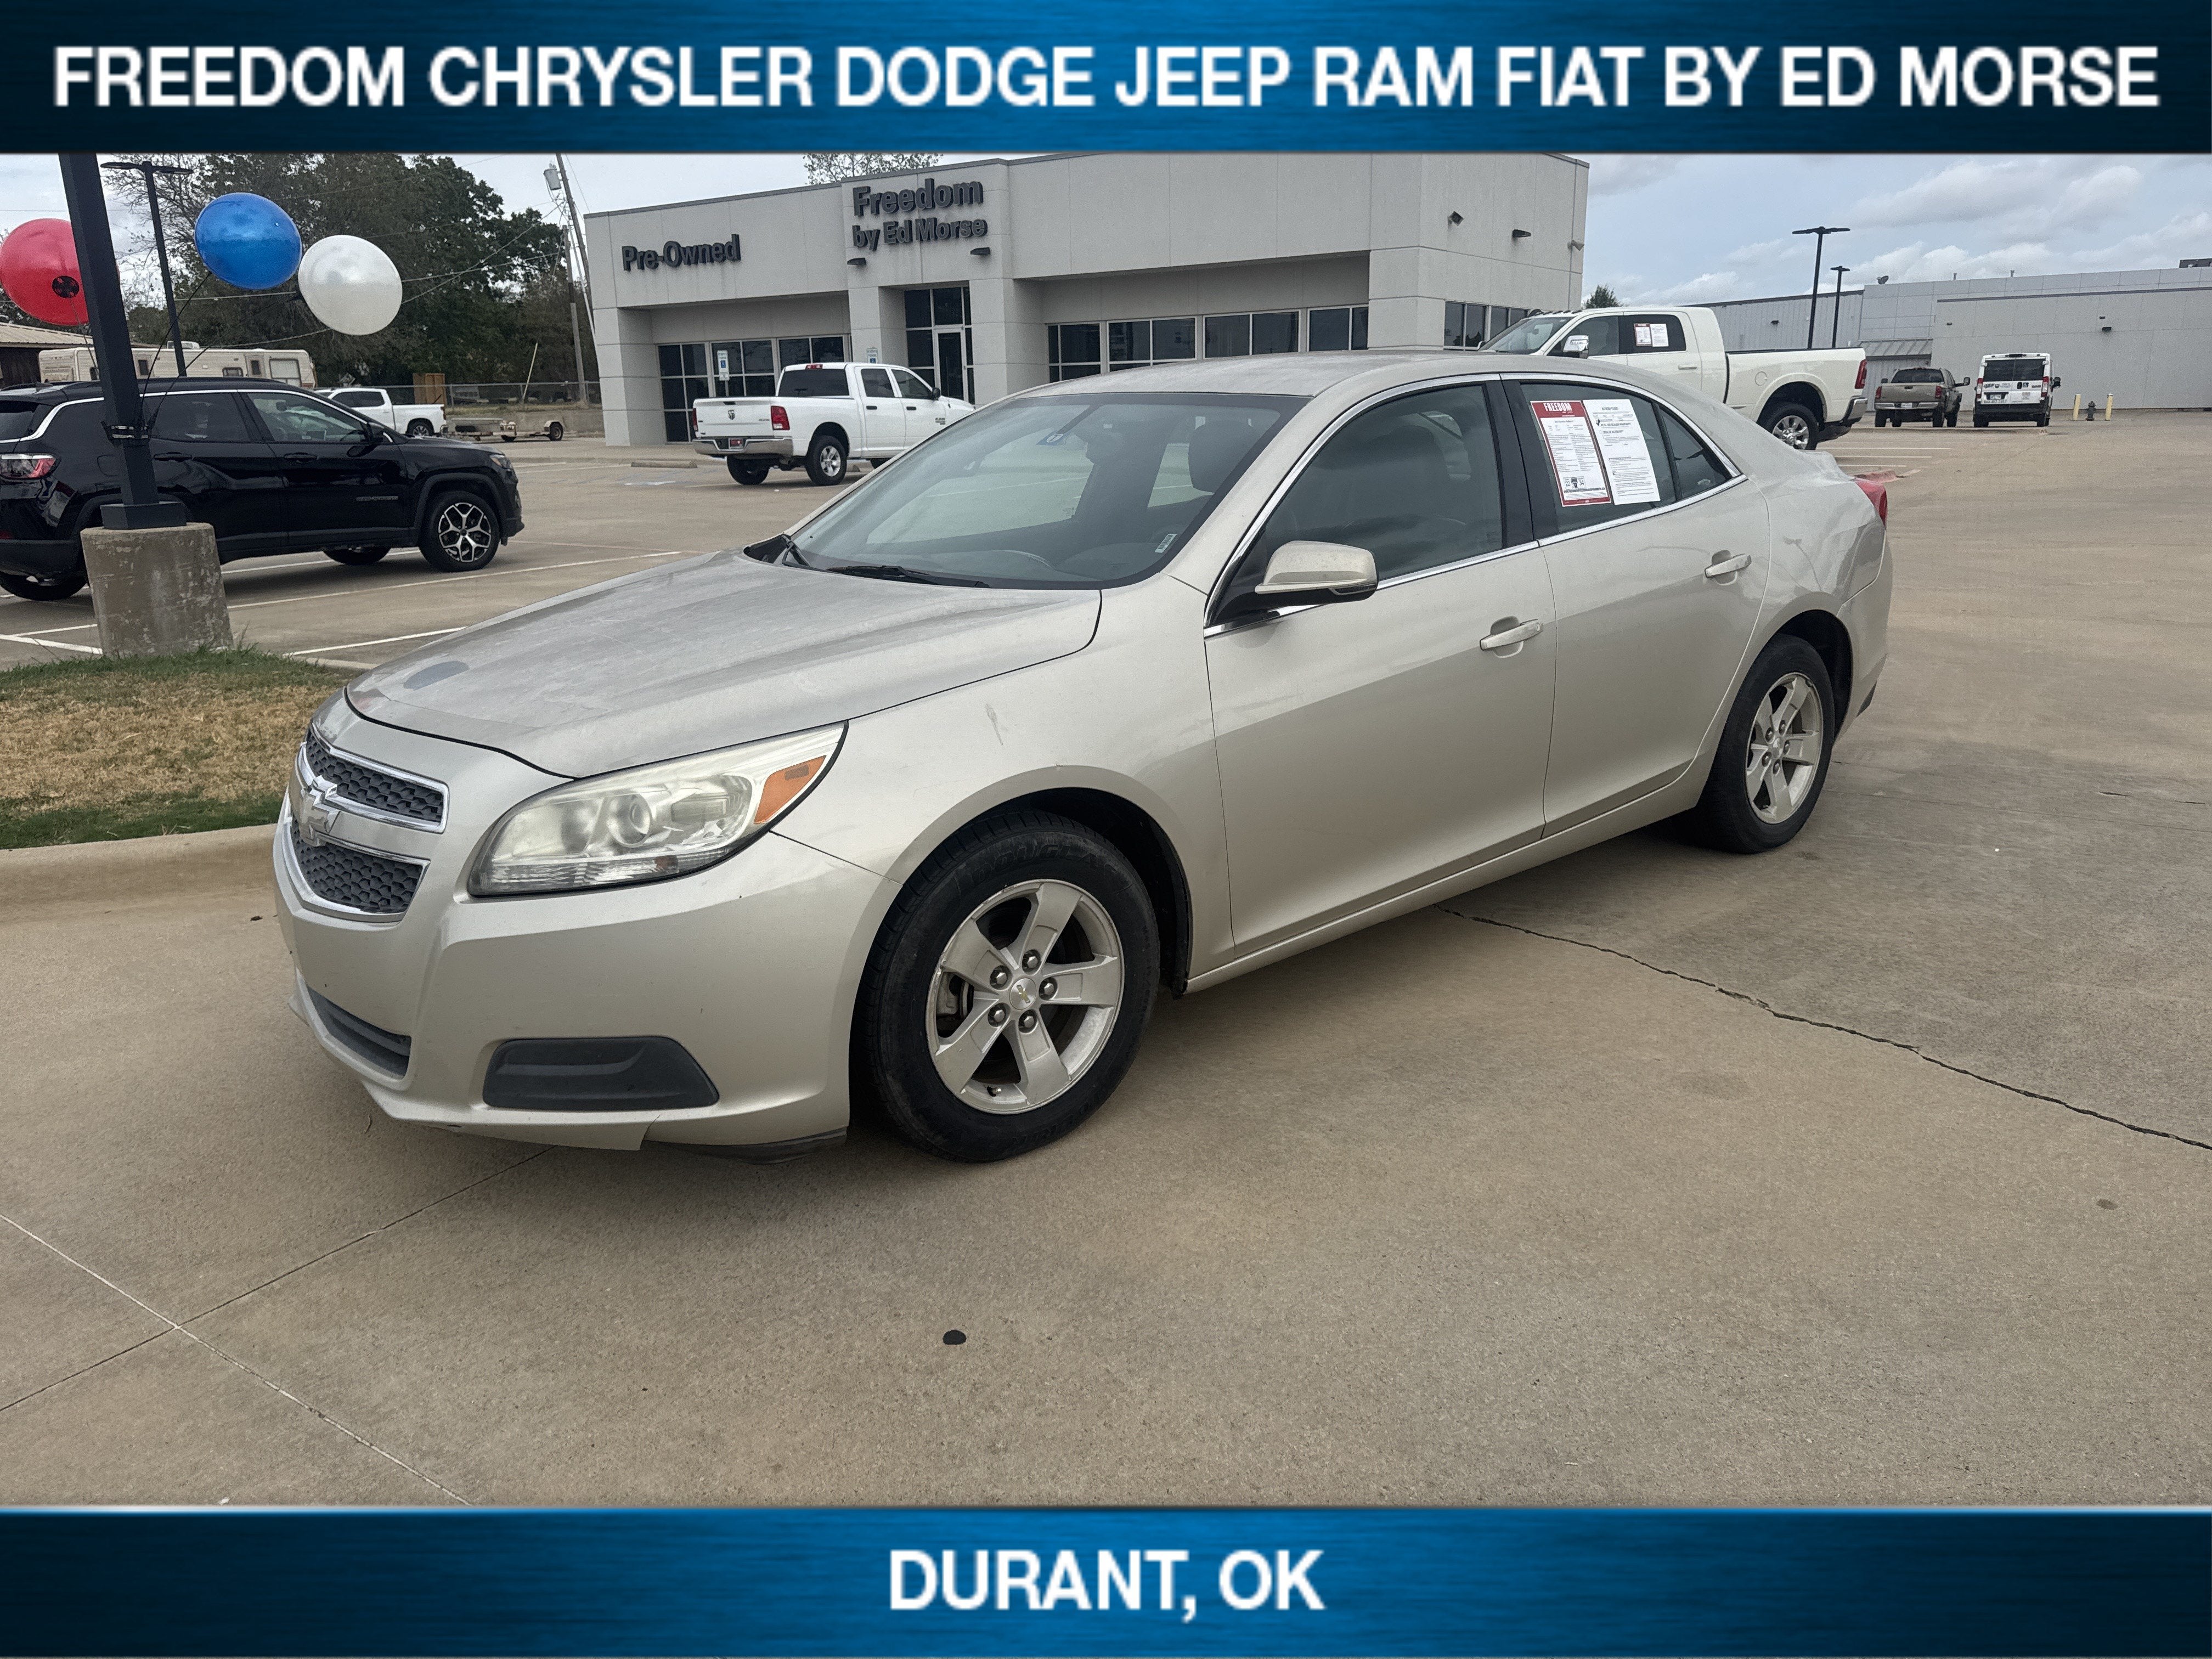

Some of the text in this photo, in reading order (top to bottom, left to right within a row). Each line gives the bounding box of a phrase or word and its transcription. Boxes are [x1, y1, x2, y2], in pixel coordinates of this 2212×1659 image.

[853, 178, 984, 216] Freedom
[852, 217, 988, 251] by Ed Morse
[622, 234, 741, 272] Pre-Owned
[1543, 402, 1572, 412] FREEDOM
